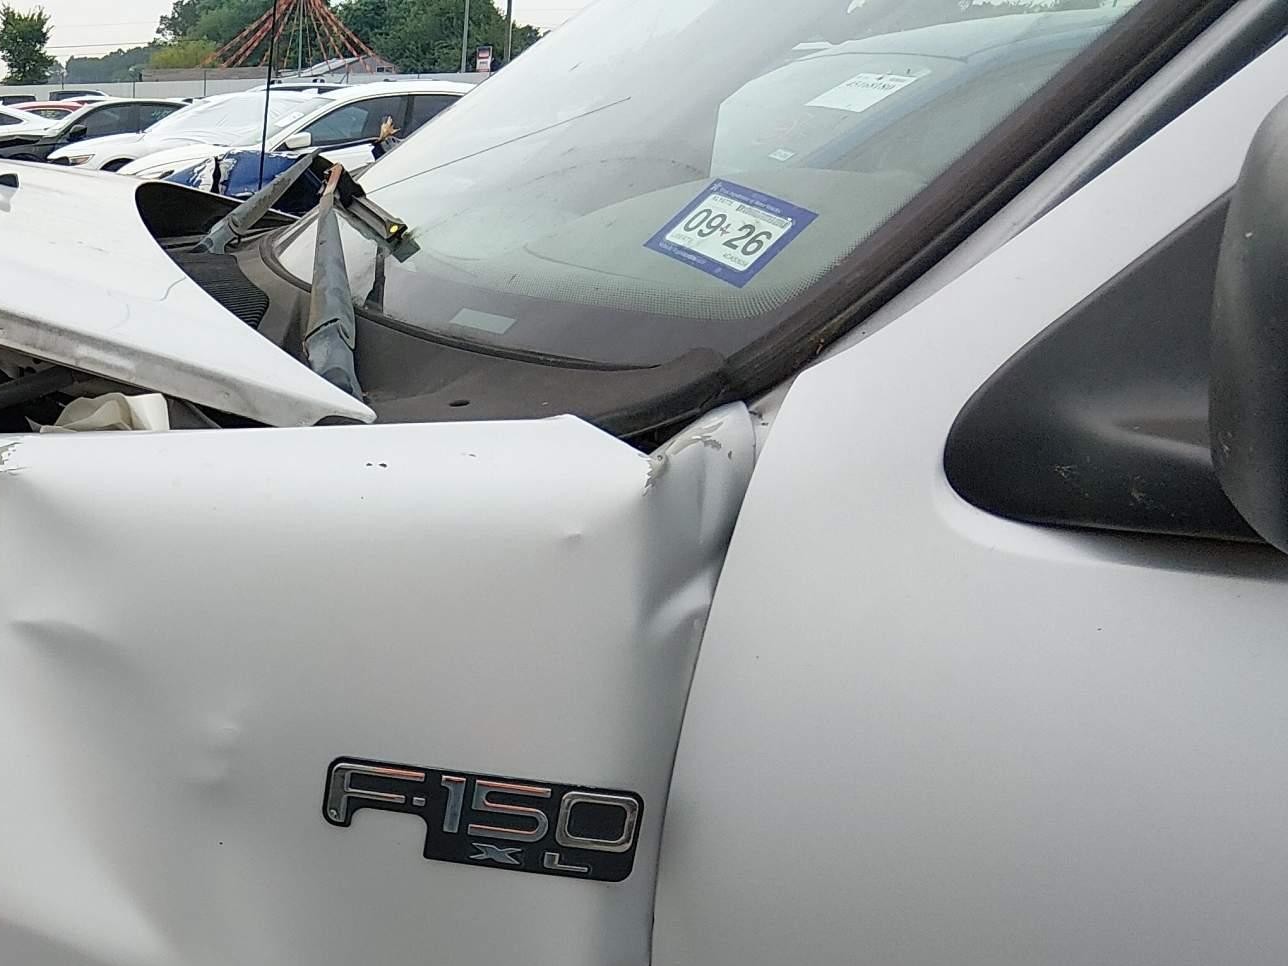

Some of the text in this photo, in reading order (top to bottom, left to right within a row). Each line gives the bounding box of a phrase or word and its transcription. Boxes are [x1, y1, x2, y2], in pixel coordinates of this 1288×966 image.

[683, 208, 728, 238] 09
[722, 223, 773, 256] 26
[327, 761, 640, 854] F-150
[469, 842, 589, 873] XL
